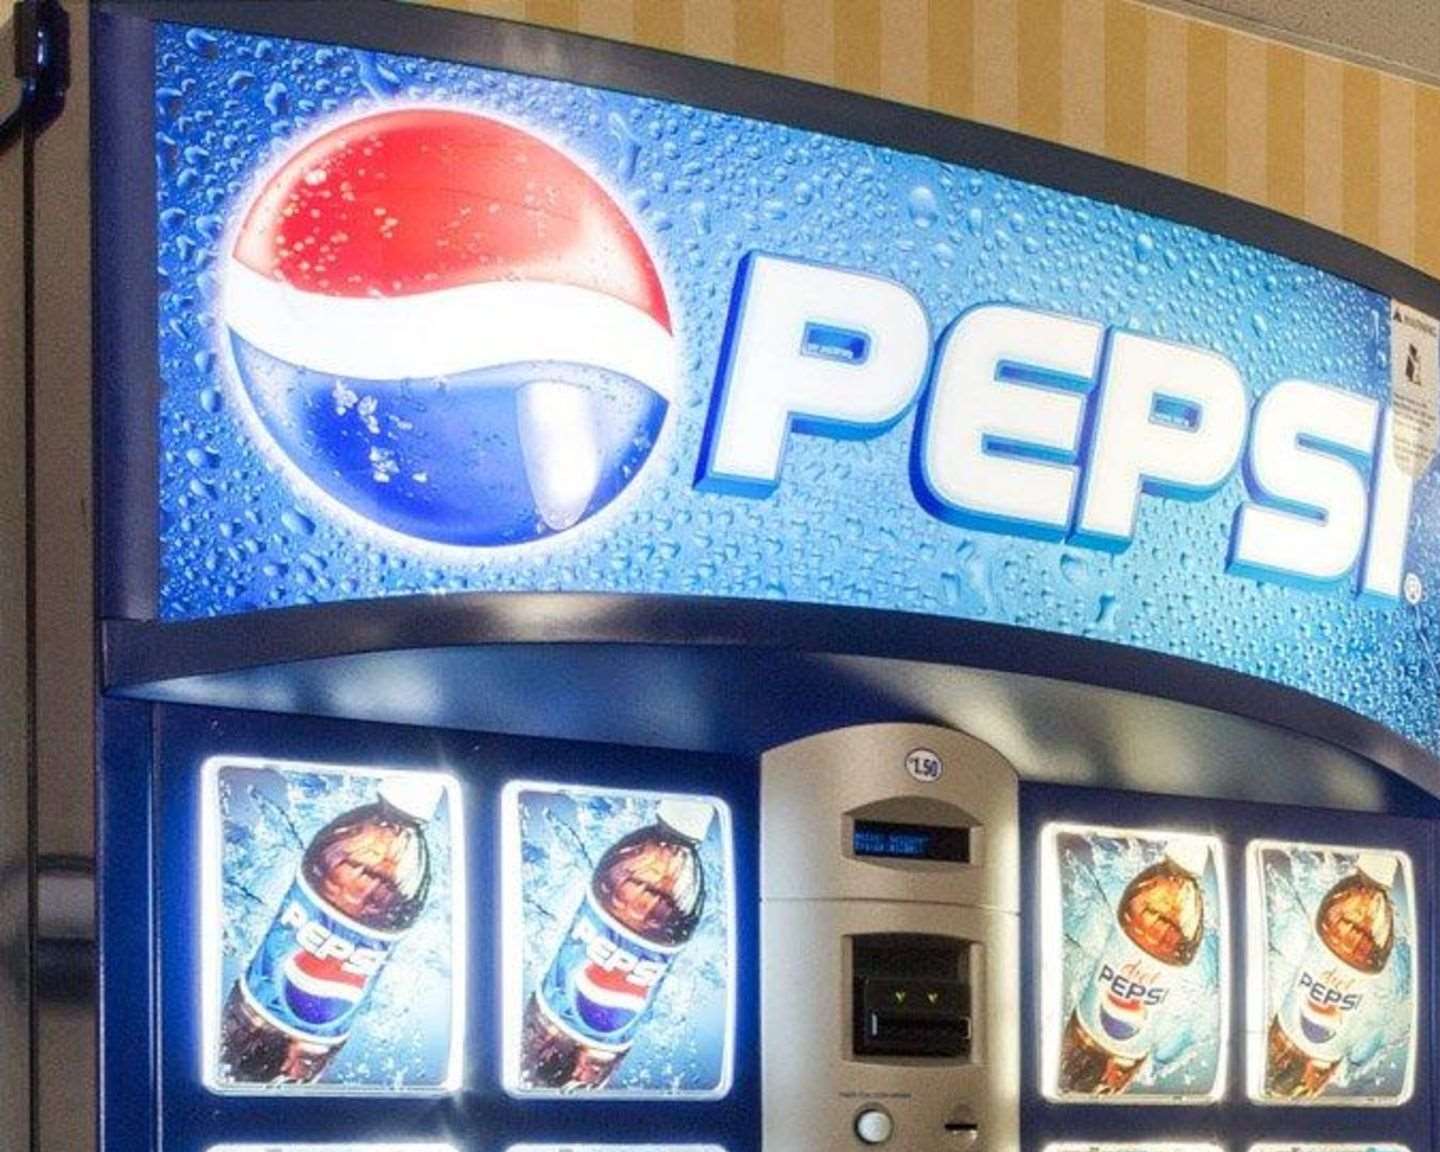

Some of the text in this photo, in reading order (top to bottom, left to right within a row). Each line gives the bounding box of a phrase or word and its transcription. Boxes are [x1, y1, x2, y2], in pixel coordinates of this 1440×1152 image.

[697, 250, 1415, 600] PEPSI
[1098, 964, 1169, 1006] PEPSI
[1299, 971, 1363, 1010] PEPSI
